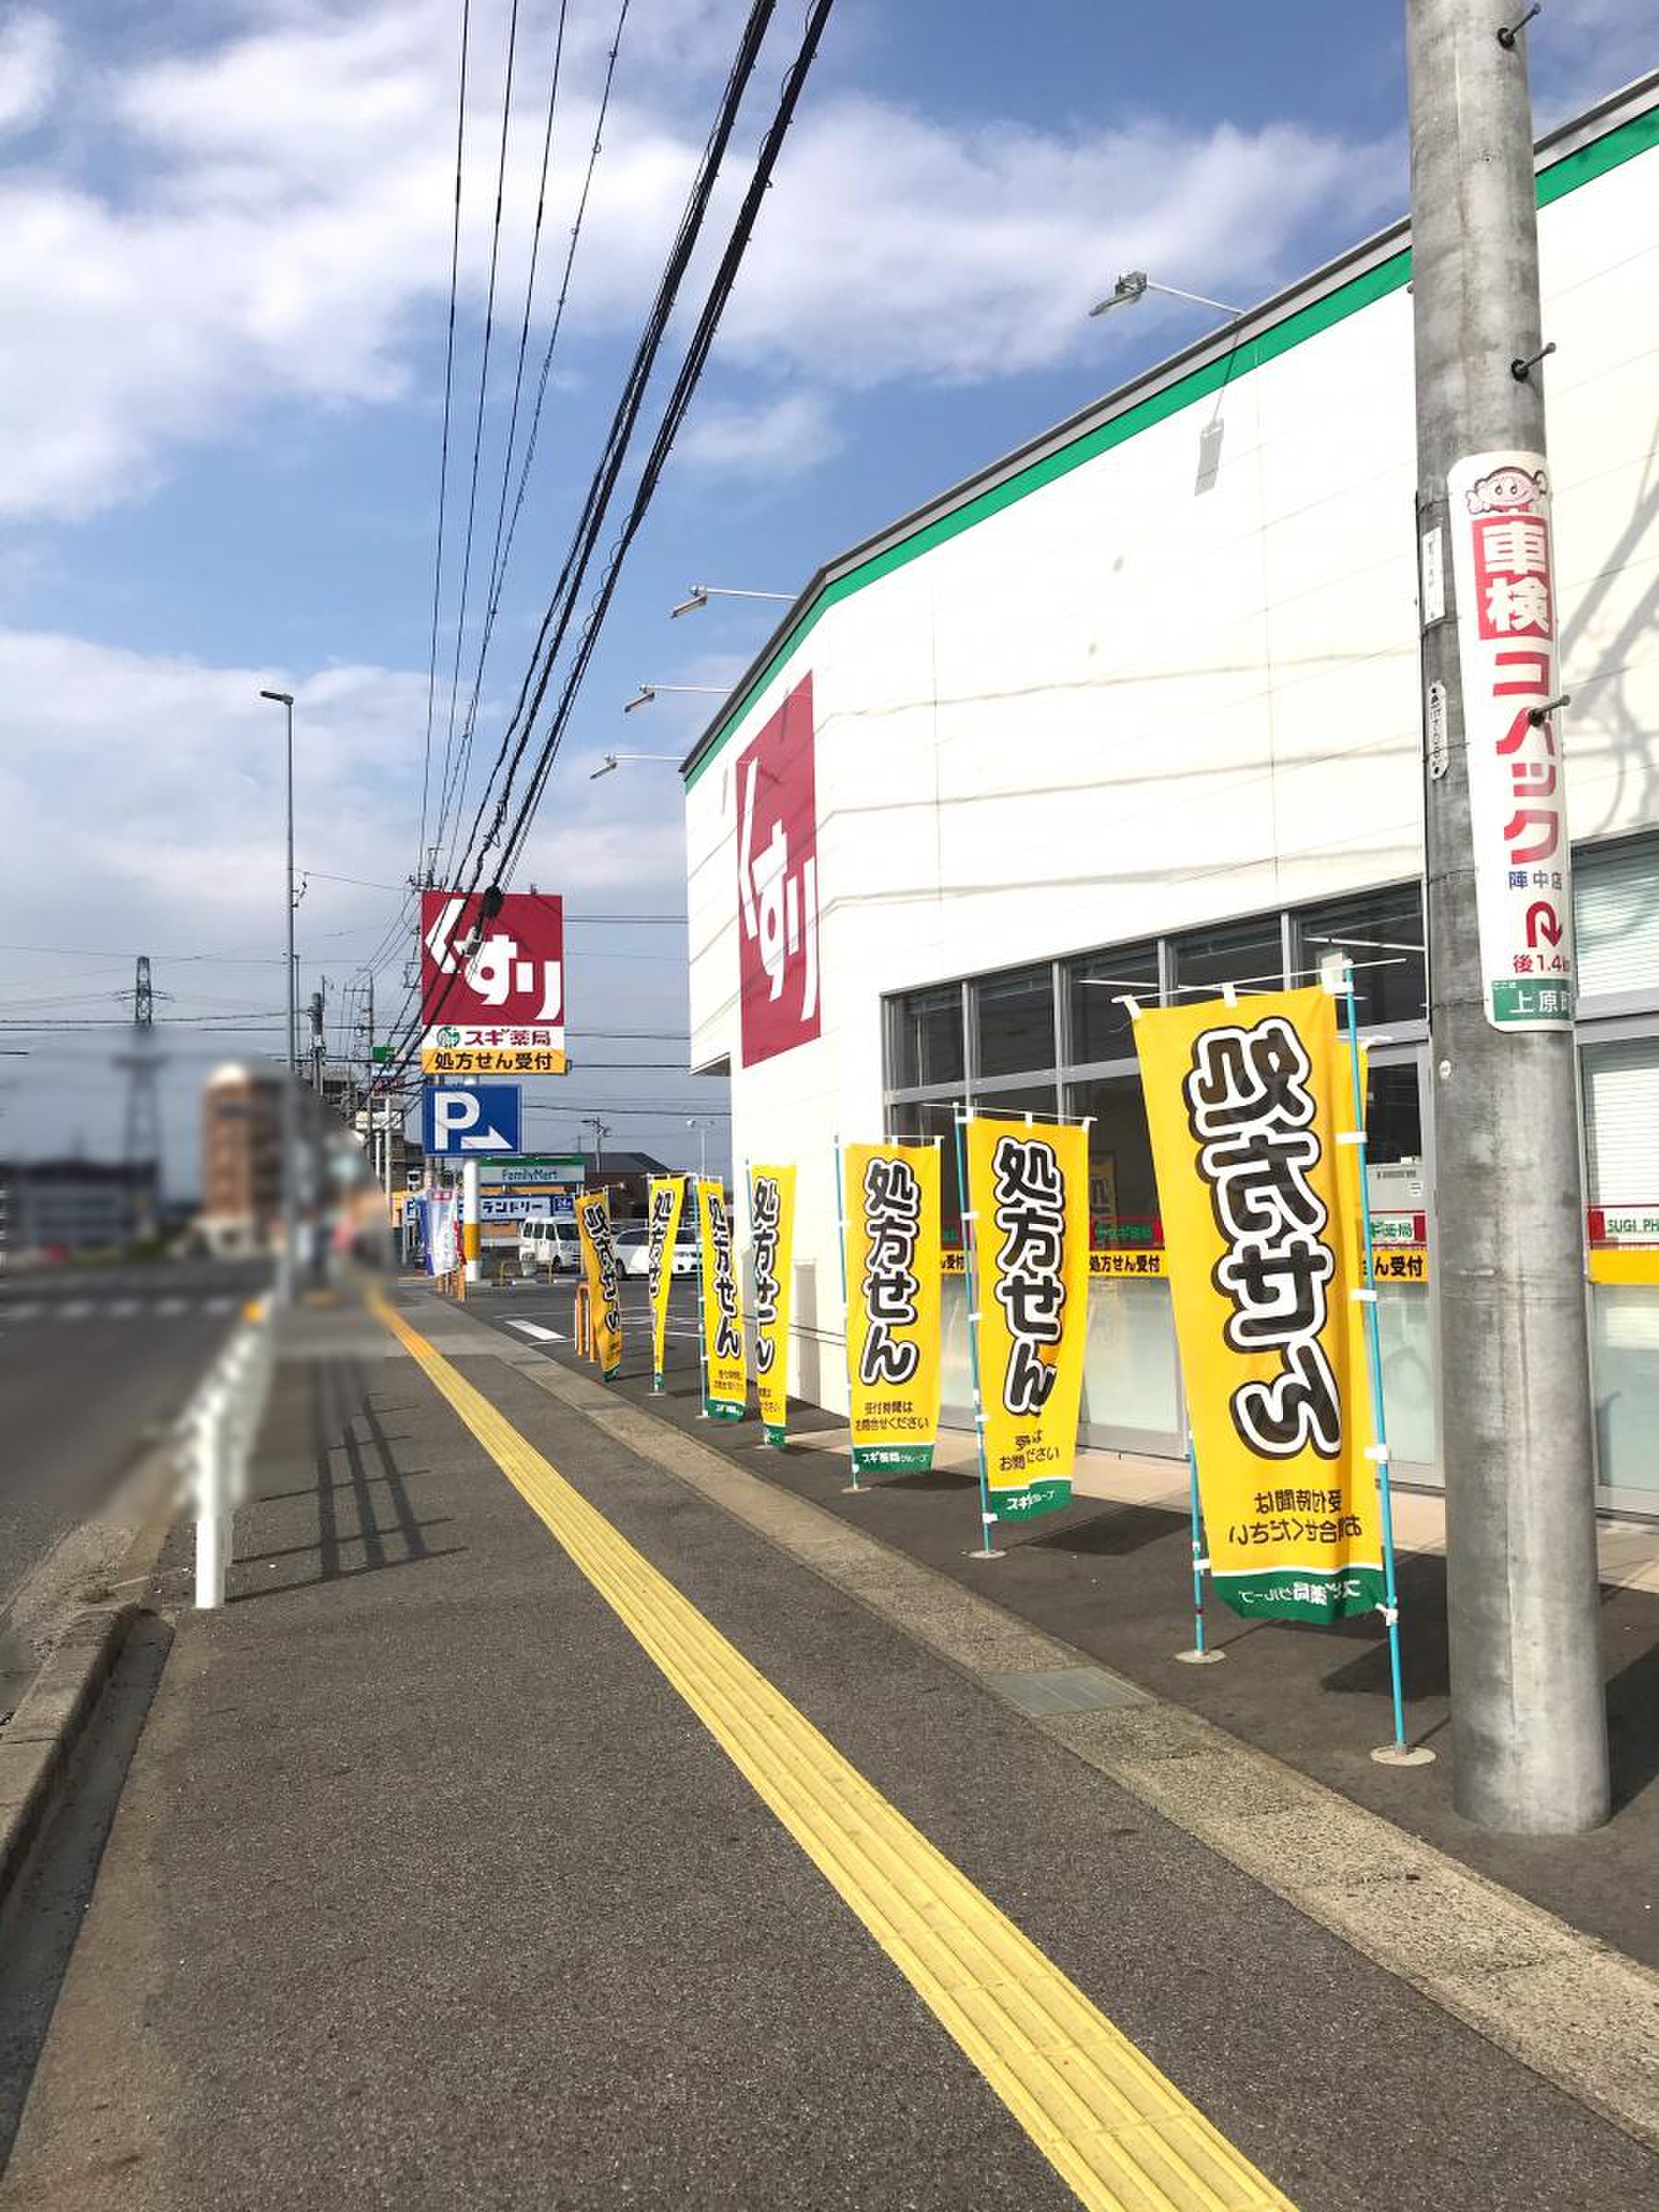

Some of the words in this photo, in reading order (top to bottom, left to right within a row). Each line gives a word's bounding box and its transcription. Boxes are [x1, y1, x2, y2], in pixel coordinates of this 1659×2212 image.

[1481, 520, 1550, 634] 車検
[737, 756, 818, 1022] くすり
[424, 898, 562, 1020] くすり
[434, 1052, 553, 1071] 処方せん受付
[465, 1029, 551, 1047] スギ薬局
[434, 1092, 480, 1150] P
[860, 1159, 922, 1386] 処方せん
[990, 1135, 1065, 1418] 処方せん
[1607, 1218, 1637, 1233] SUGI
